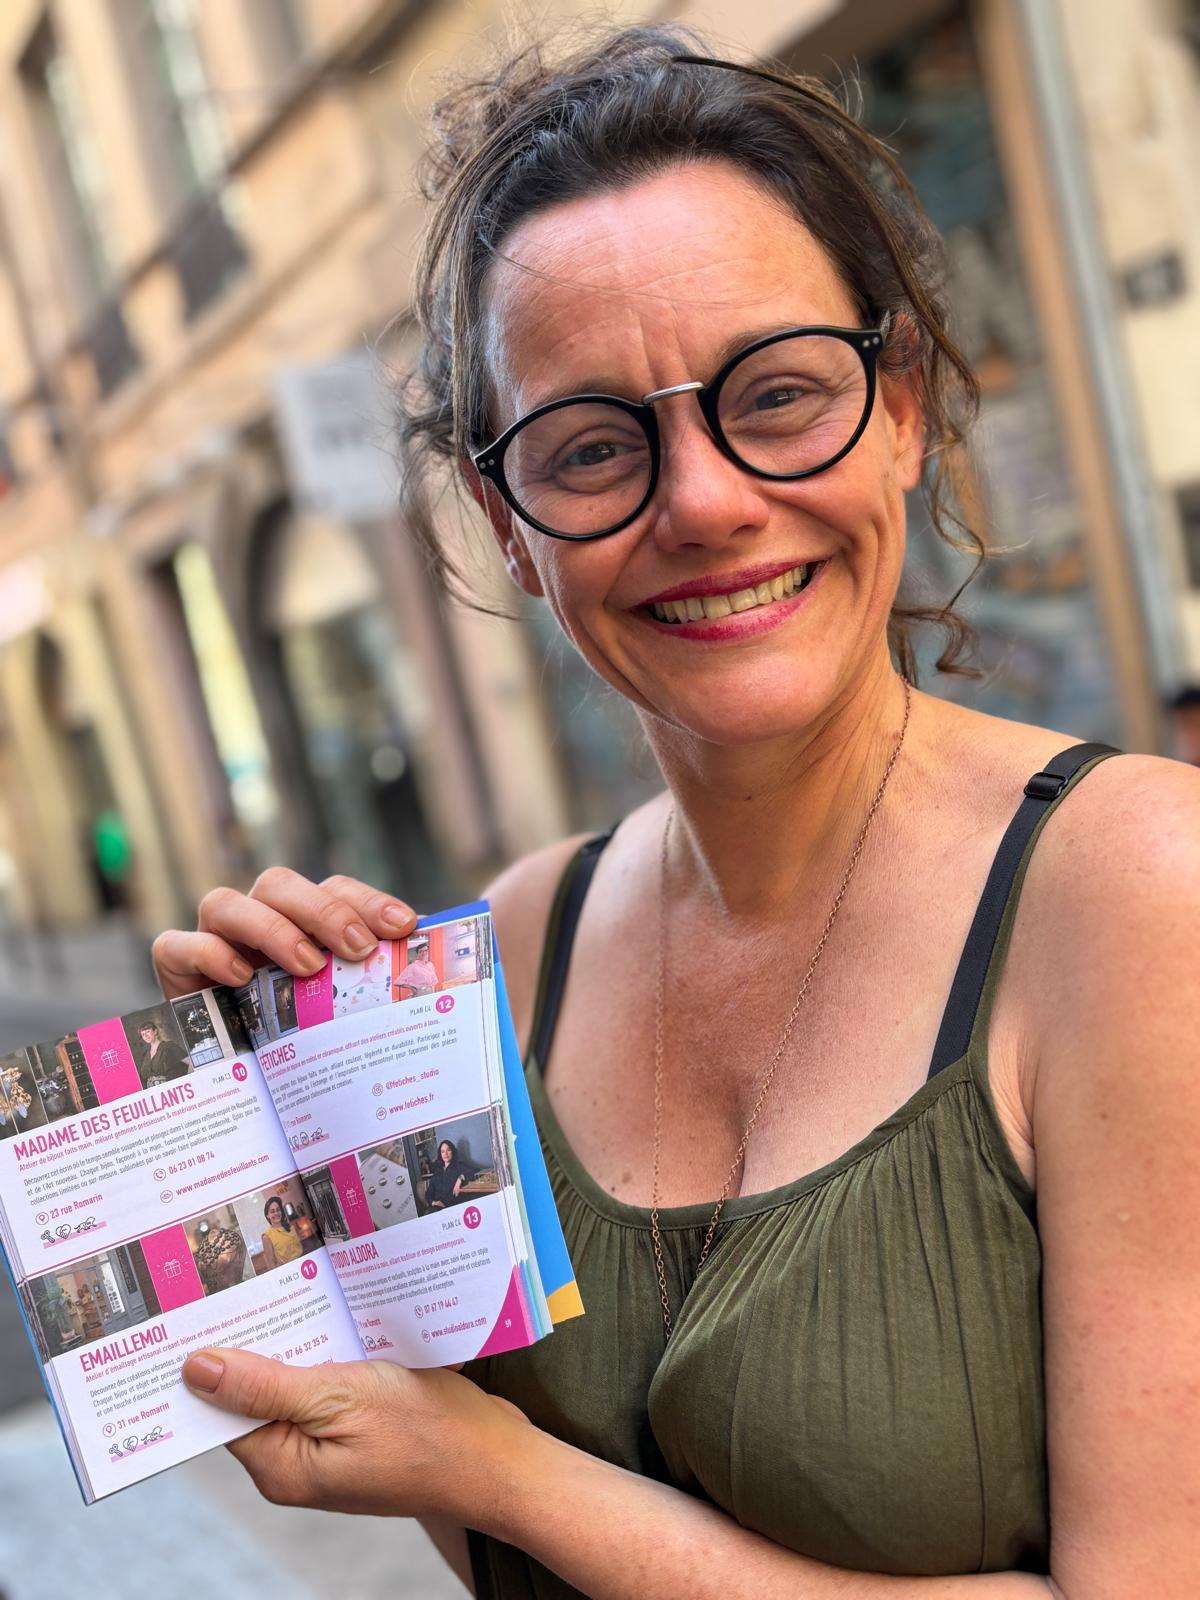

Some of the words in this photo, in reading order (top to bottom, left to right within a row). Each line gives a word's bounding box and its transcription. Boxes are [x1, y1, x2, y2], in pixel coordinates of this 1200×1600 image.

[438, 998, 451, 1010] 12
[234, 1066, 245, 1078] 10
[12, 1123, 79, 1161] MADAME
[80, 1112, 111, 1137] DES
[111, 1082, 195, 1125] FEUILLANTS
[18, 1159, 38, 1171] Atelier
[38, 1156, 46, 1164] de
[46, 1150, 63, 1162] bijoux
[64, 1145, 77, 1154] faits
[93, 1132, 113, 1144] mêlant
[137, 1114, 165, 1129] précieuses
[171, 1102, 197, 1116] matériaux
[23, 1171, 49, 1186] Découvrez
[49, 1168, 59, 1177] cet
[85, 1153, 101, 1165] temps
[101, 1146, 120, 1158] semble
[120, 1137, 144, 1152] suspendu
[144, 1135, 150, 1143] et
[167, 1164, 177, 1174] 06
[177, 1160, 187, 1171] 23
[205, 1150, 215, 1160] 74
[174, 1152, 270, 1196] www.madamedesfeuillants.com
[30, 1190, 59, 1205] collections
[58, 1182, 80, 1195] limitées
[145, 1157, 154, 1165] par
[34, 1185, 41, 1193] de
[79, 1164, 99, 1178] Chaque
[49, 1208, 59, 1218] 23
[60, 1205, 72, 1215] rue
[72, 1192, 103, 1210] Romarin
[441, 1220, 454, 1230] PLAN
[465, 1211, 479, 1224] 13
[347, 1240, 379, 1264] ALDORA
[278, 1274, 293, 1286] PLAN
[302, 1263, 315, 1276] 11
[79, 1323, 168, 1372] EMAILLEMOI
[85, 1370, 104, 1382] Atelier
[104, 1357, 137, 1375] d'émaillage
[137, 1347, 161, 1361] artisanal
[161, 1340, 179, 1351] créant
[179, 1333, 197, 1345] bijoux
[203, 1324, 220, 1336] objets
[220, 1318, 233, 1328] déco
[241, 1308, 258, 1319] cuivre
[268, 1295, 288, 1308] accents
[89, 1381, 117, 1397] Découvrez
[116, 1377, 126, 1386] des
[126, 1367, 150, 1382] créations
[150, 1357, 177, 1374] vibrantes,
[228, 1325, 254, 1341] fusionnent
[255, 1322, 267, 1331] pour
[278, 1311, 288, 1320] des
[288, 1304, 304, 1317] pièces
[284, 1348, 294, 1359] 07
[293, 1344, 303, 1355] 66
[302, 1340, 312, 1351] 32
[92, 1393, 113, 1408] Chaque
[114, 1387, 128, 1400] bijou
[128, 1384, 134, 1392] et
[135, 1378, 149, 1391] objet
[149, 1374, 159, 1383] est
[255, 1330, 269, 1340] votre
[95, 1409, 102, 1417] et
[103, 1406, 113, 1414] une
[113, 1397, 132, 1409] touche
[132, 1385, 160, 1402] d'exotisme
[116, 1418, 126, 1429] 31
[127, 1415, 140, 1425] rue
[140, 1400, 170, 1419] Romarin
